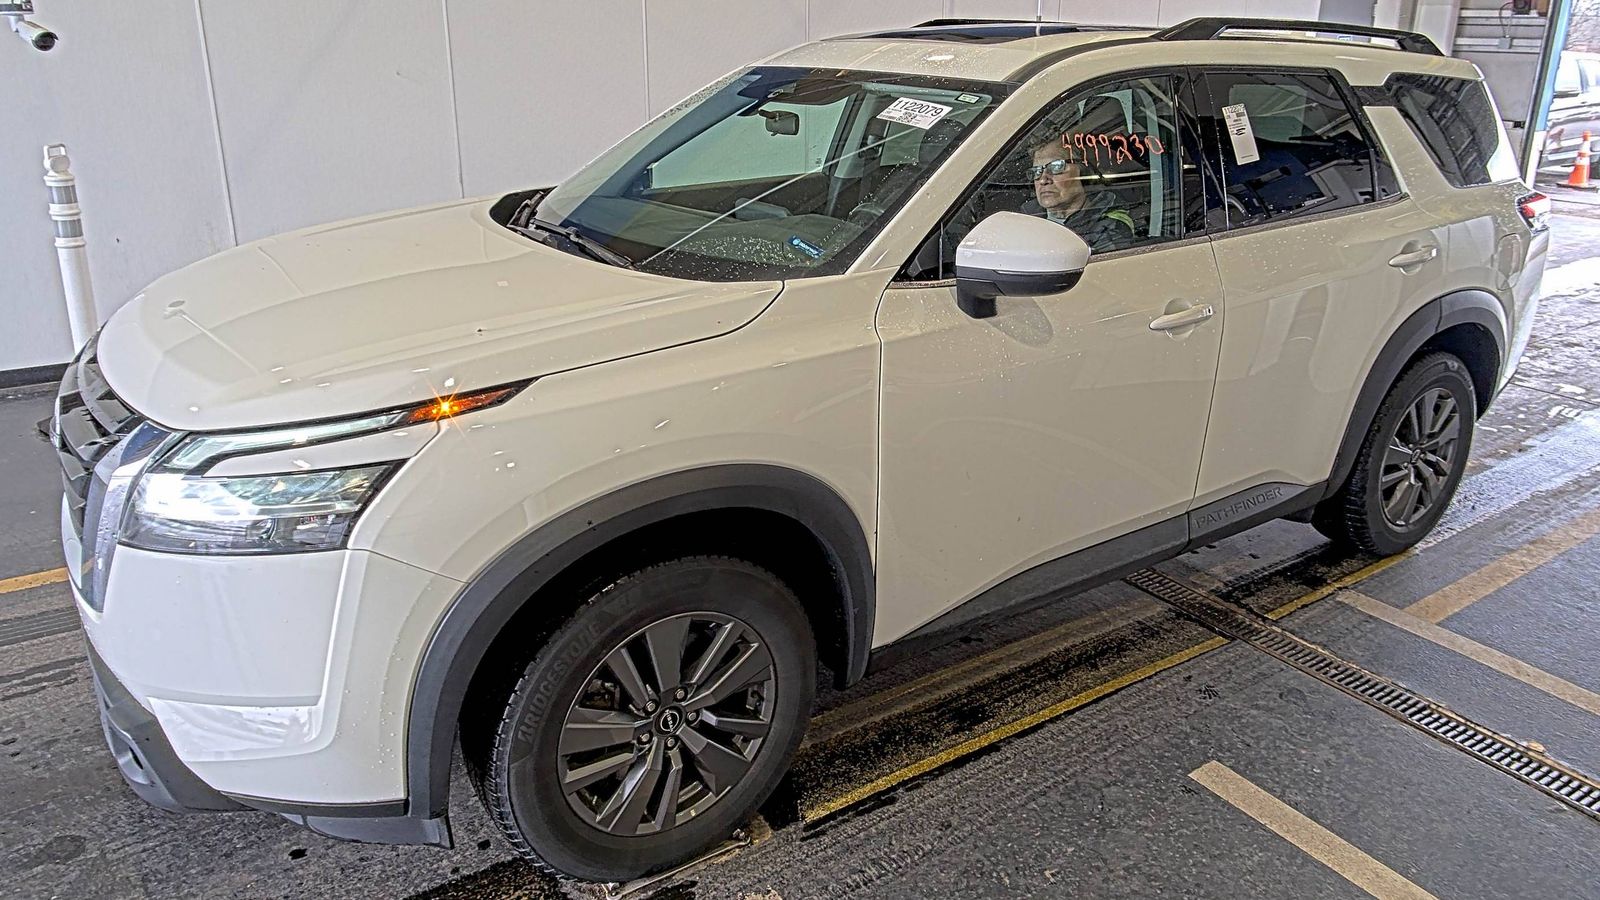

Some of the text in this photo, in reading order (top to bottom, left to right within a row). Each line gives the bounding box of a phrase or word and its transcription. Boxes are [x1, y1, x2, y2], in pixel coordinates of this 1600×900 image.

[893, 100, 943, 117] 1122079
[1195, 487, 1283, 528] PATHFINDER
[518, 621, 602, 743] BRIDGESTONE
